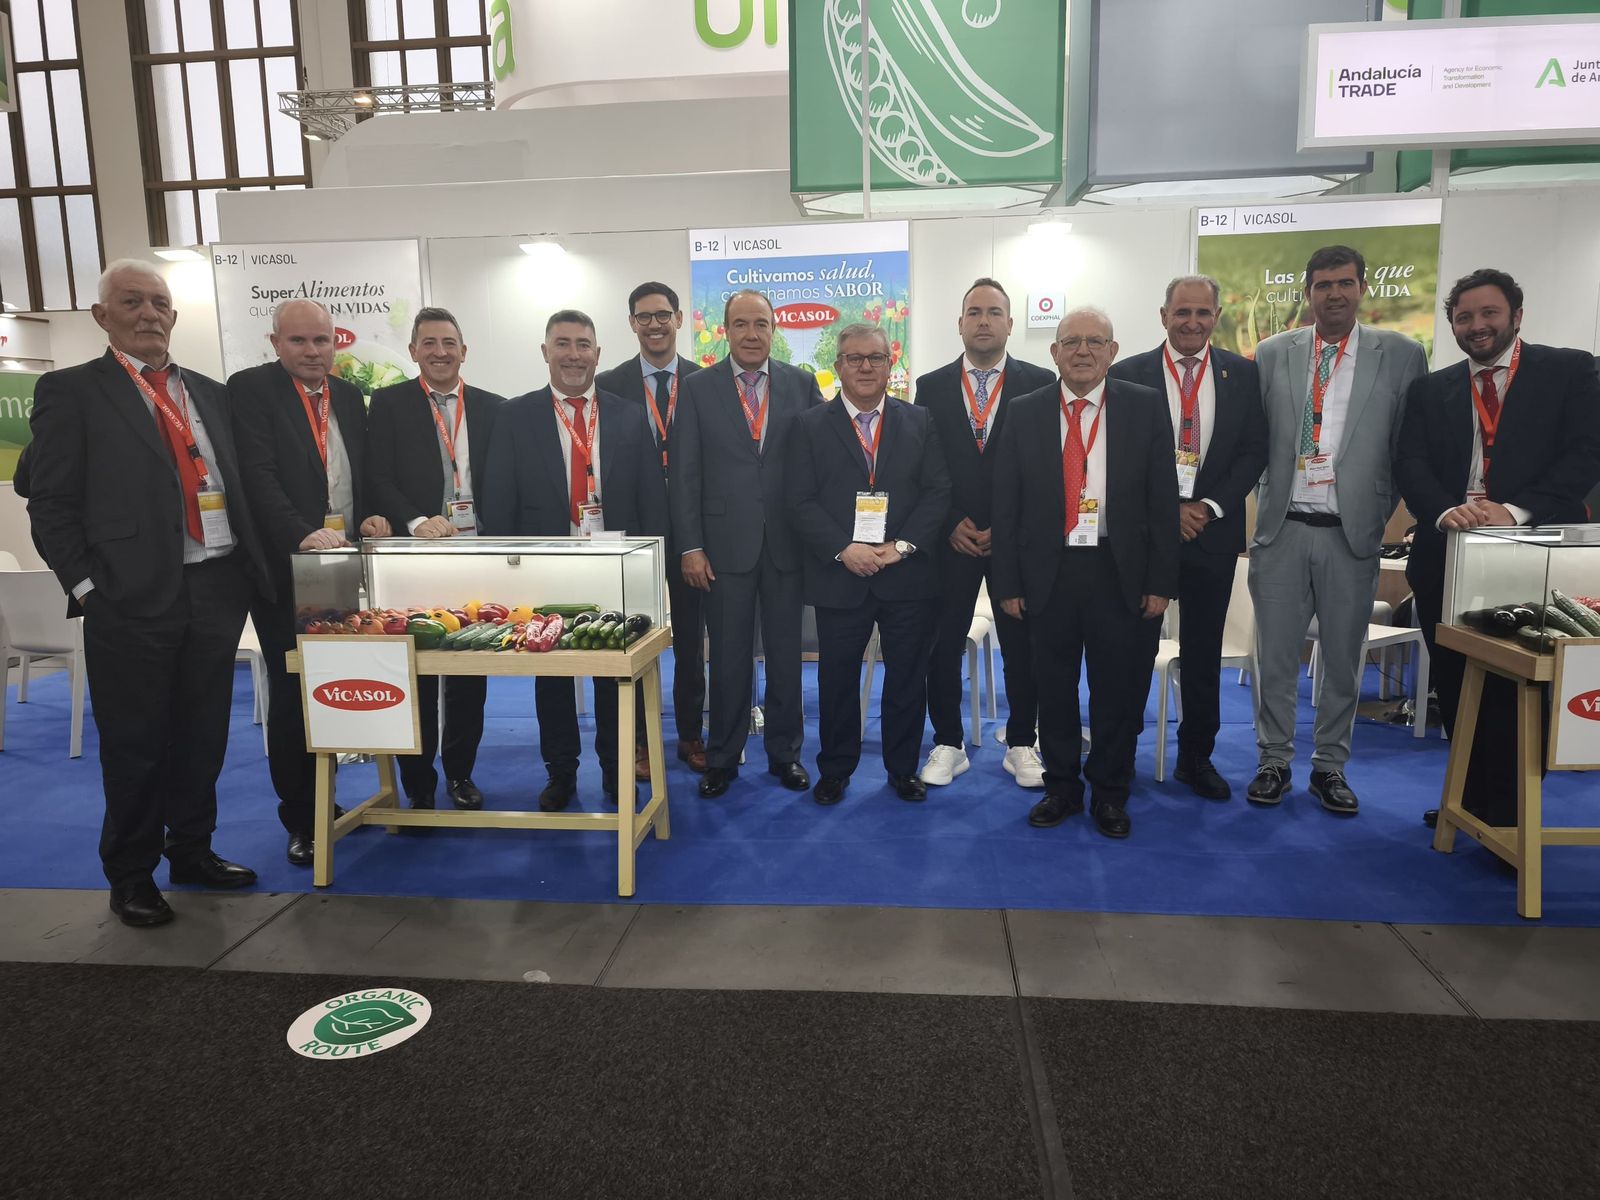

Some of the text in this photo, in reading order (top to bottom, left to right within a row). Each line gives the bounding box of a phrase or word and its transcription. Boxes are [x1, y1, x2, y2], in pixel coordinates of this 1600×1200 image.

[1338, 64, 1422, 82] Andalucía
[1571, 72, 1587, 83] de
[1338, 83, 1397, 98] TRADE
[1200, 212, 1297, 226] B-12 VICASOL
[695, 239, 782, 252] B-12 VICASOL
[215, 254, 297, 265] B-12 VICASOL
[727, 260, 876, 284] Cultivamos salud,
[1265, 269, 1295, 285] Las
[1375, 264, 1415, 285] que
[824, 281, 884, 298] SABOR
[1368, 283, 1411, 298] VIDA
[249, 304, 275, 319] que
[345, 302, 391, 314] VIDAS
[324, 990, 424, 1011] ORGANIC
[299, 1040, 383, 1057] ROUTE
